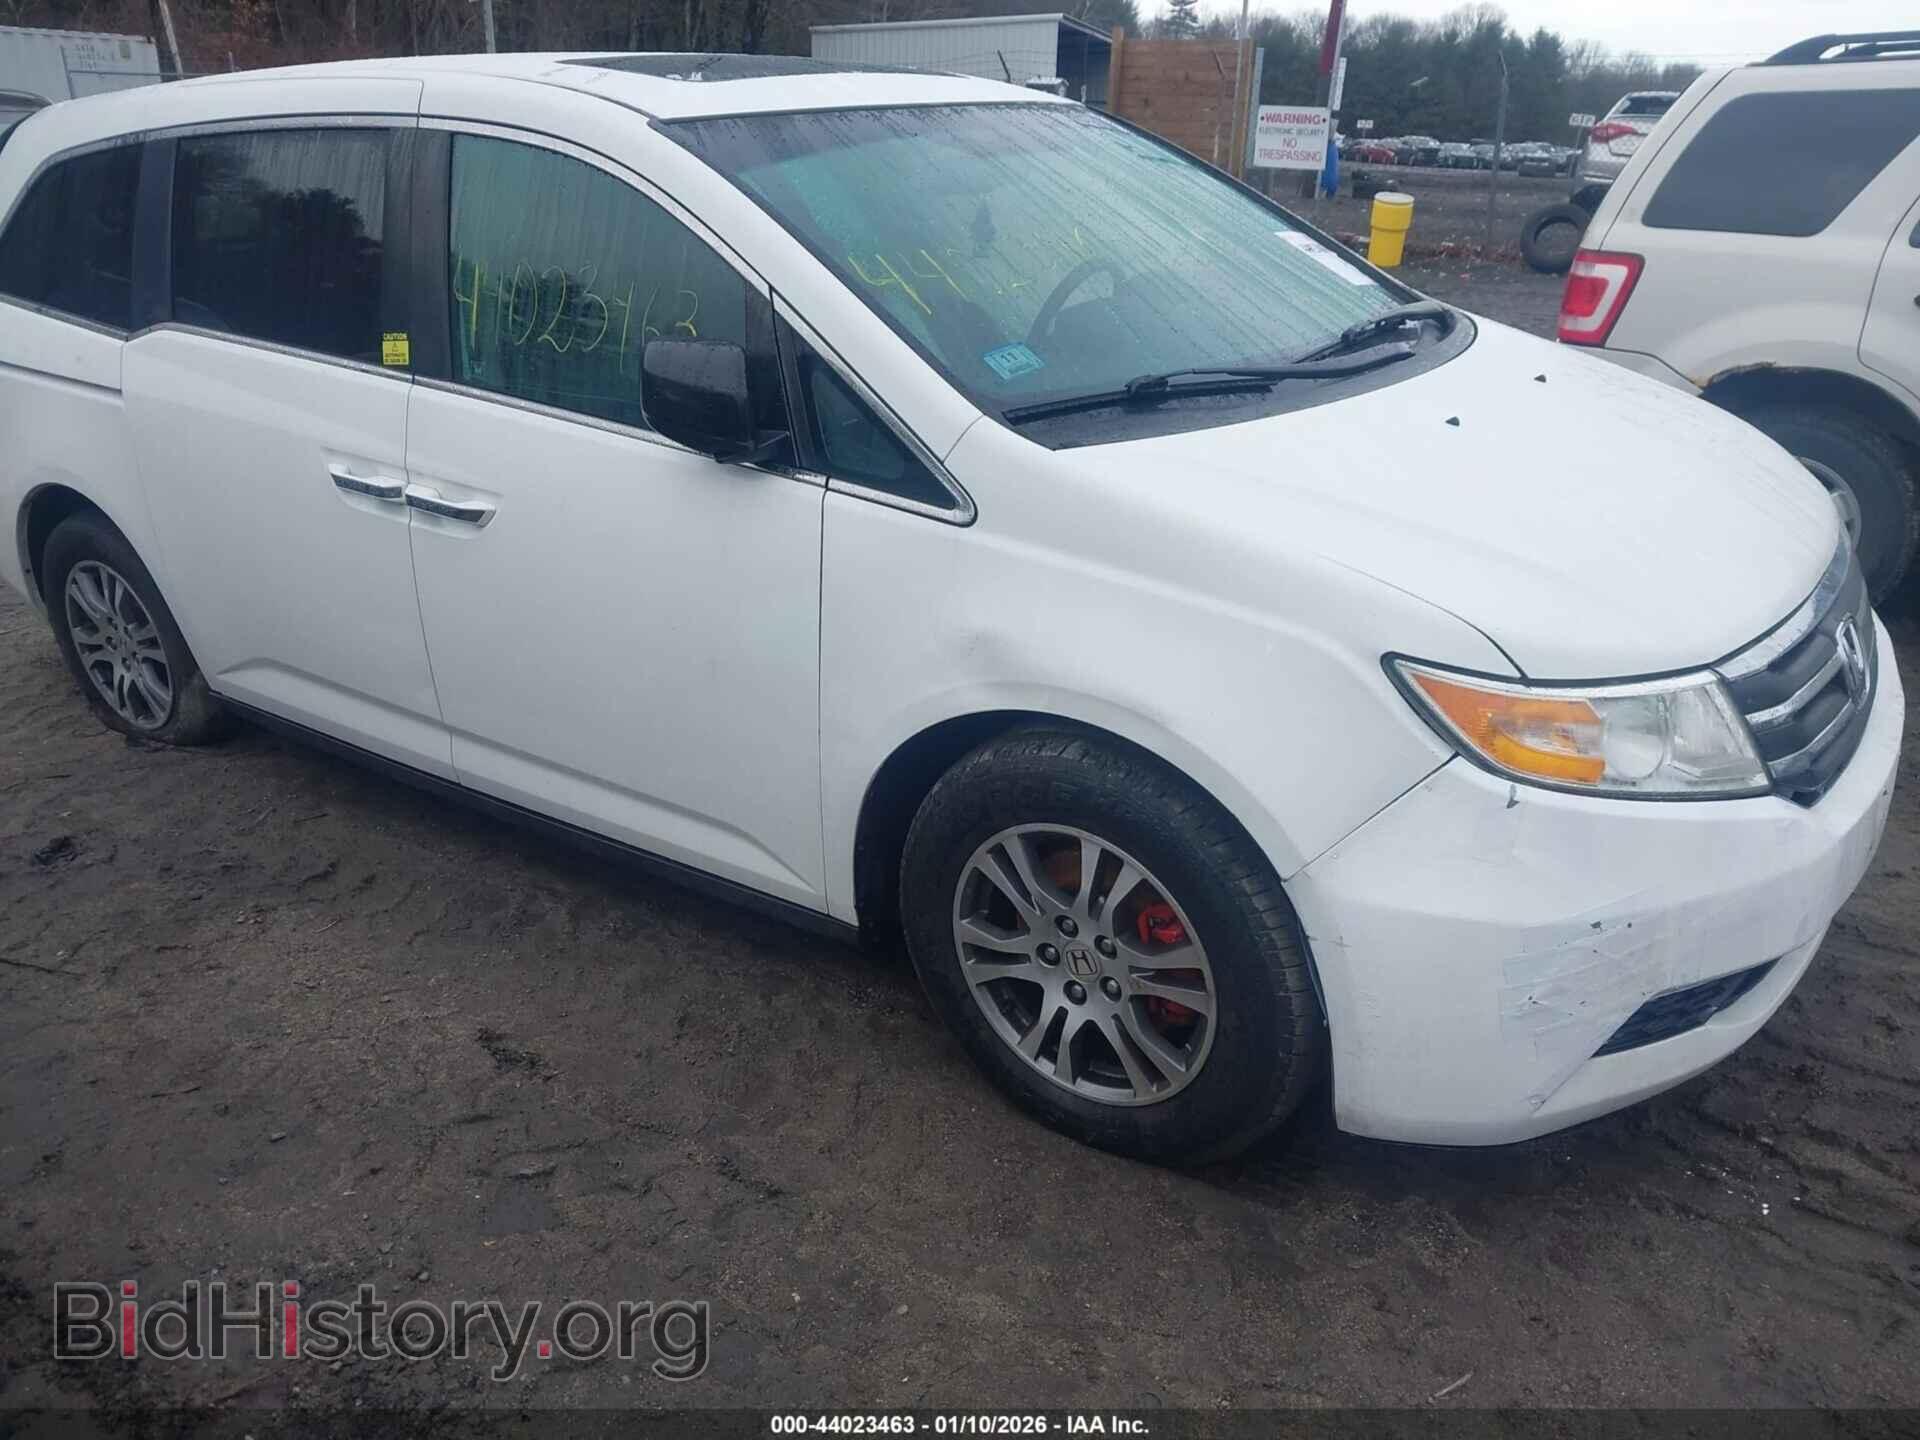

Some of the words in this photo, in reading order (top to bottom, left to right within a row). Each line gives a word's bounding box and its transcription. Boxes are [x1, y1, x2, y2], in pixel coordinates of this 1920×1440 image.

[1264, 112, 1321, 125] WARNING
[1282, 136, 1298, 148] NO
[1258, 148, 1321, 161] TRESPASSING
